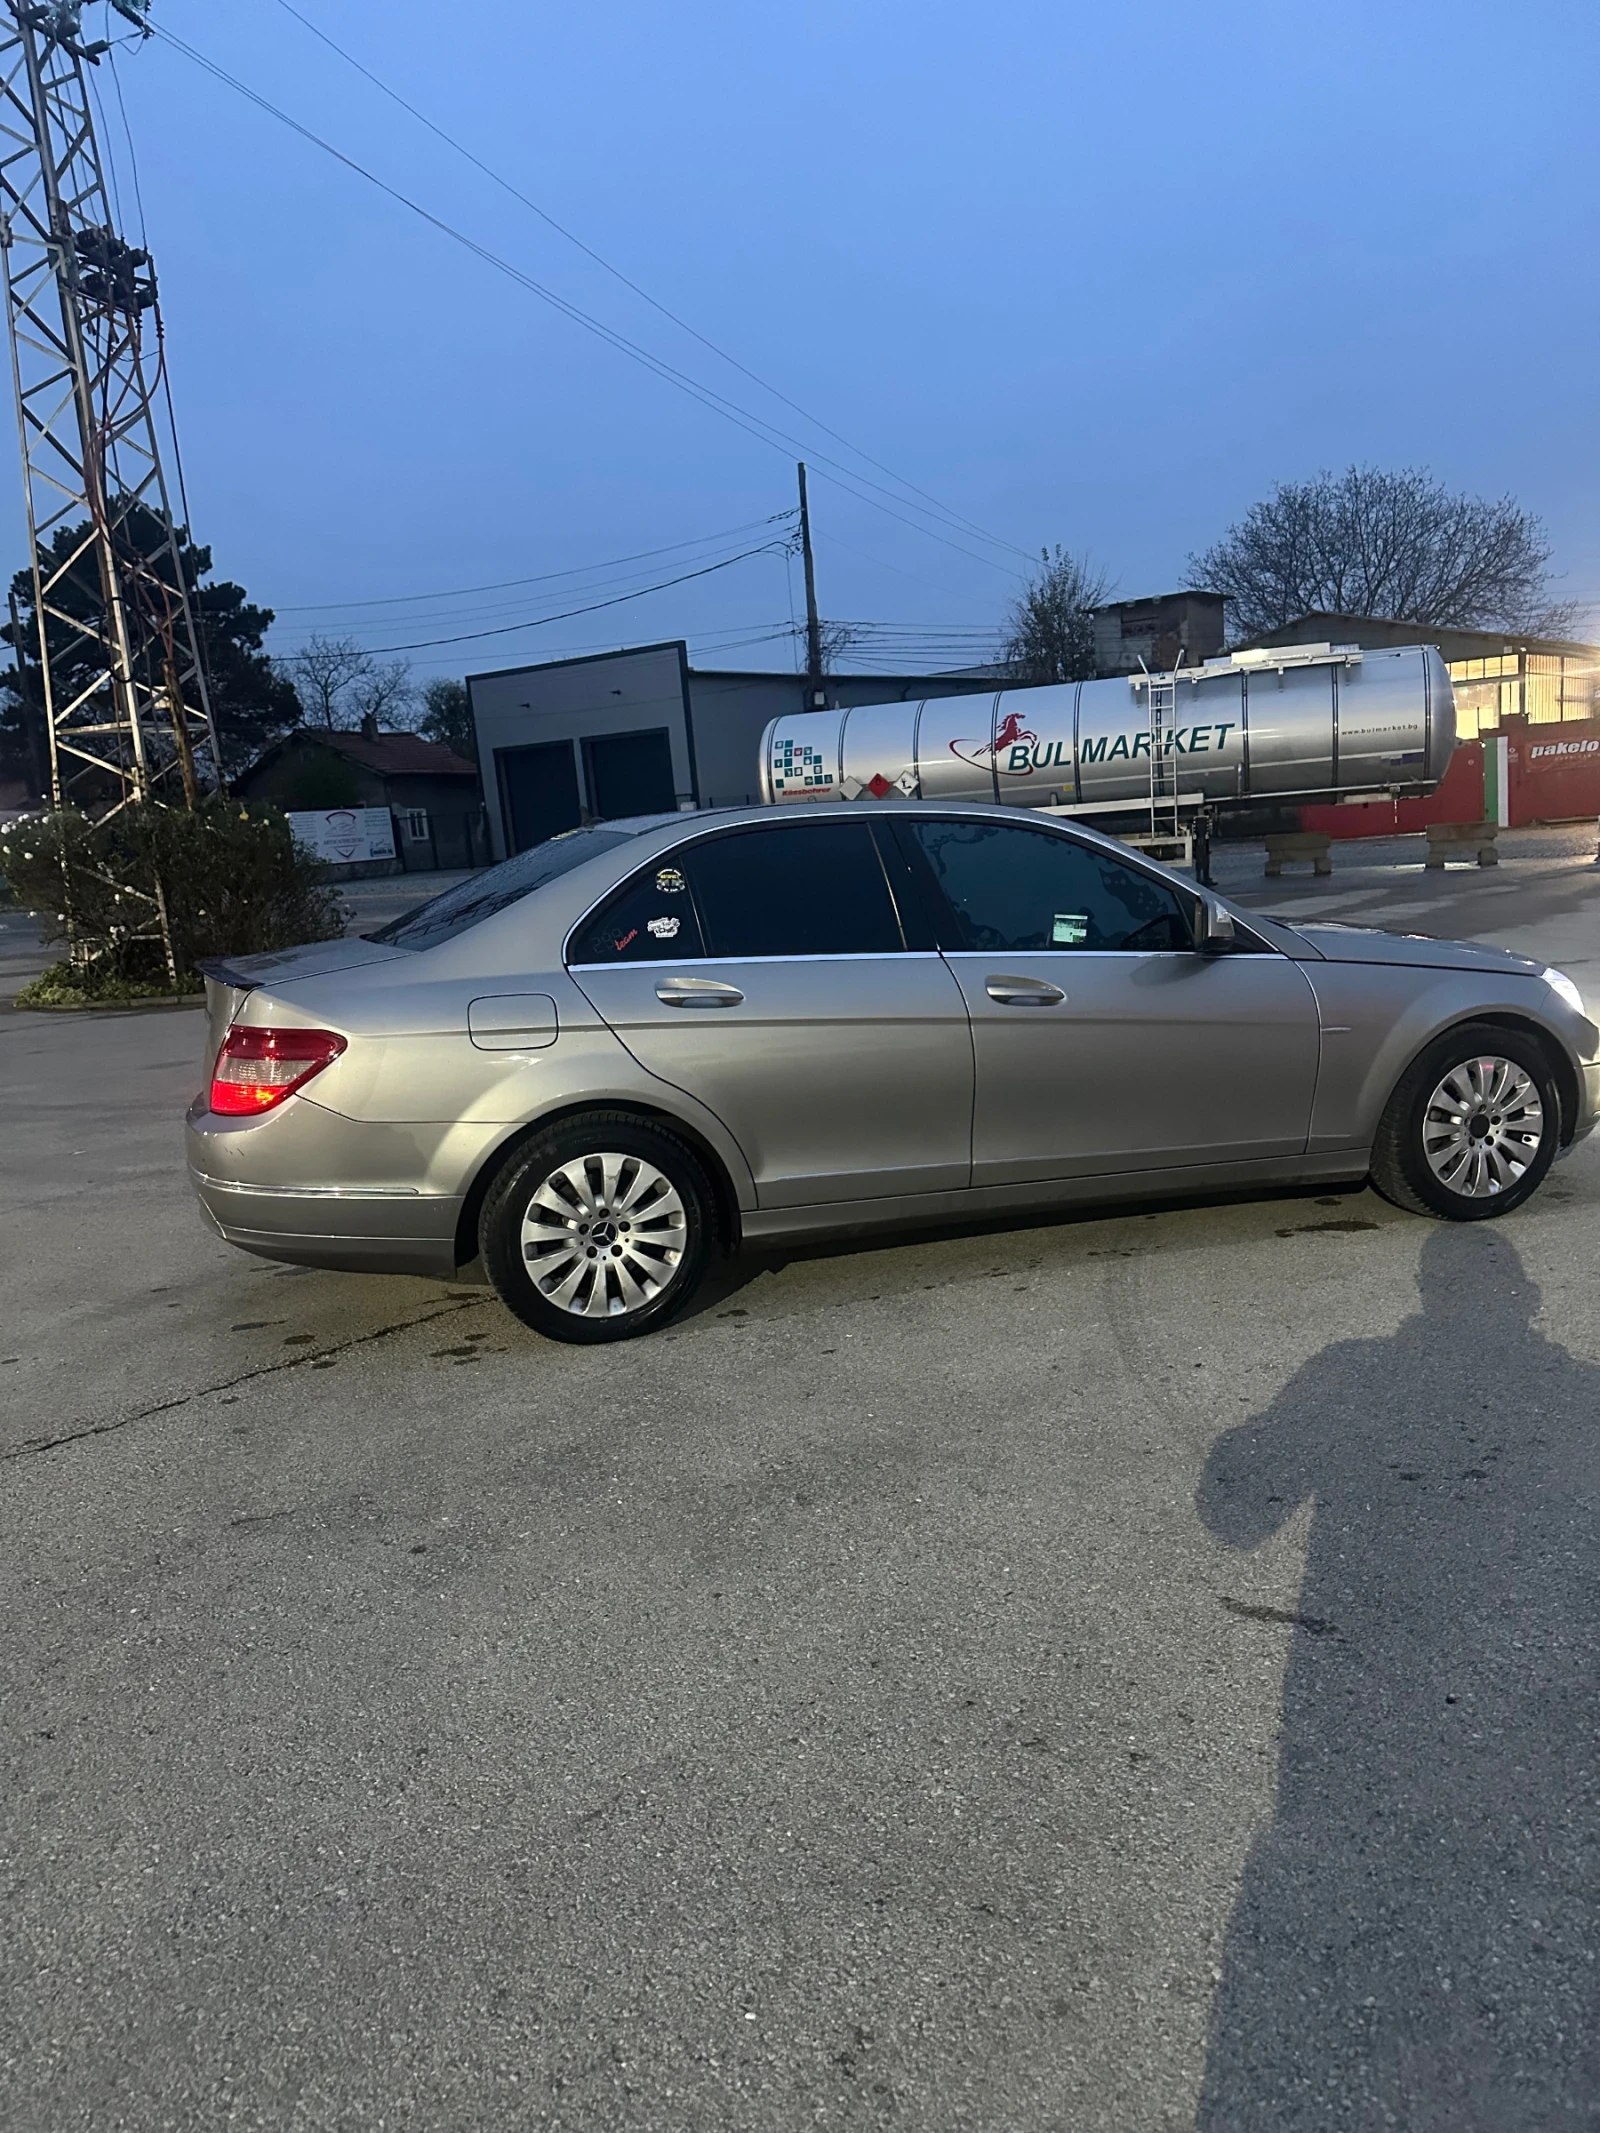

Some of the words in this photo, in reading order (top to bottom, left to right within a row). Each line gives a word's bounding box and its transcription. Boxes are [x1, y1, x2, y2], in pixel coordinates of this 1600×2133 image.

[1341, 723, 1418, 736] www.bulmarket.bg
[1530, 739, 1600, 759] pakelo
[614, 928, 639, 951] team
